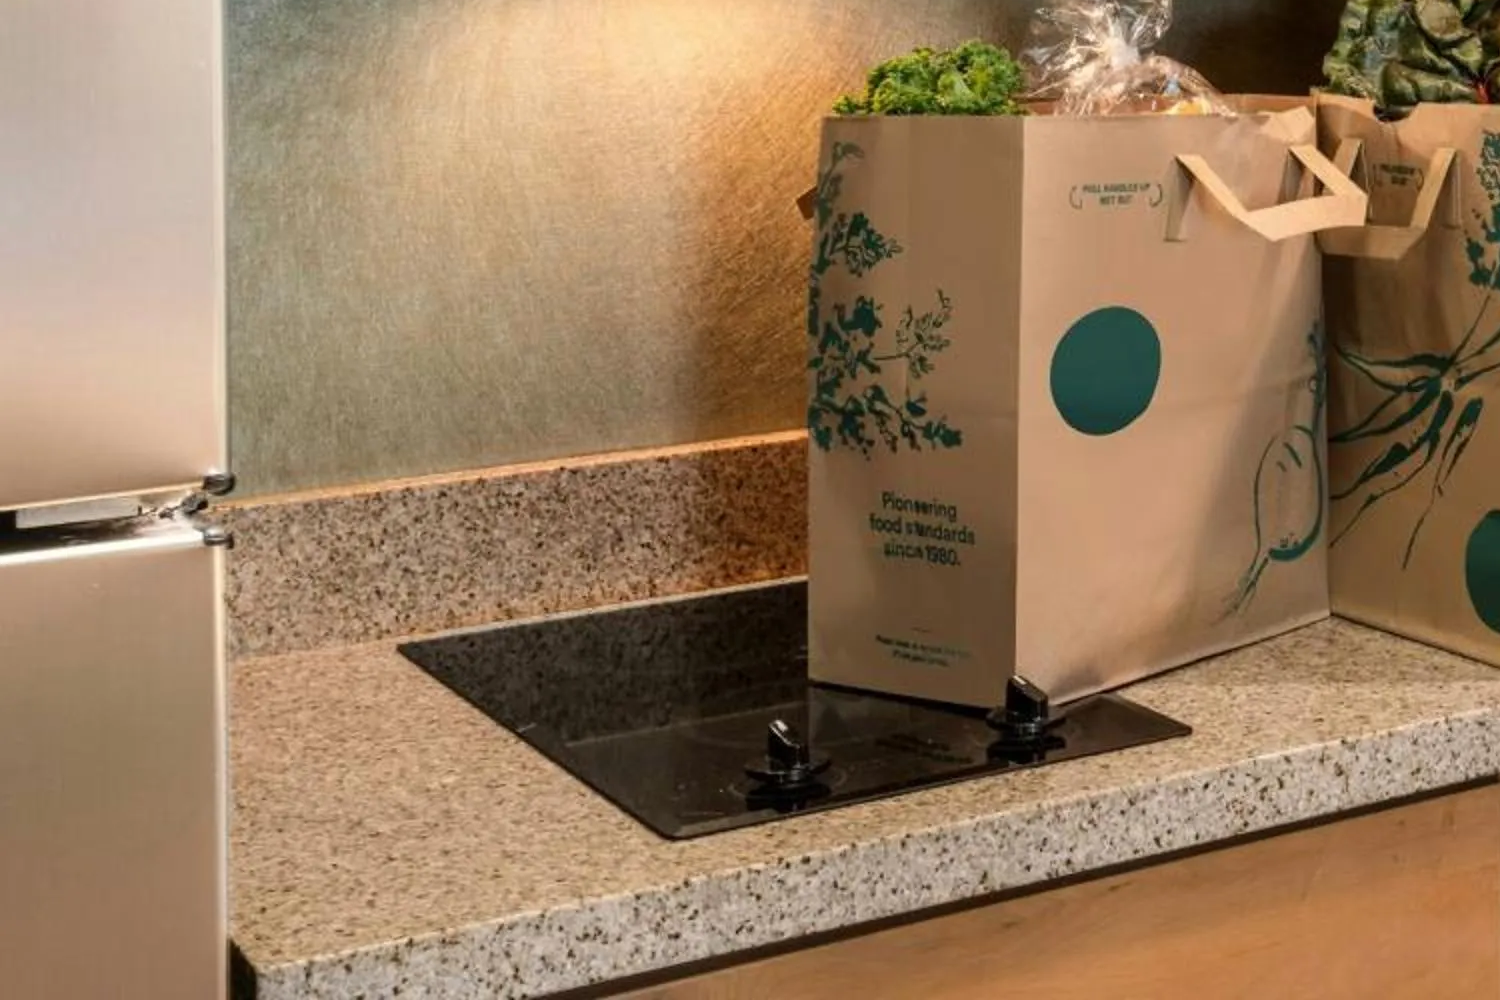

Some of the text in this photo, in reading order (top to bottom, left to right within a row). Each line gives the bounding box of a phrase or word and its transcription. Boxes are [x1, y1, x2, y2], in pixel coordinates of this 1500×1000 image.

[881, 490, 958, 523] Pioneering
[869, 512, 976, 546] food standards
[883, 539, 923, 560] since
